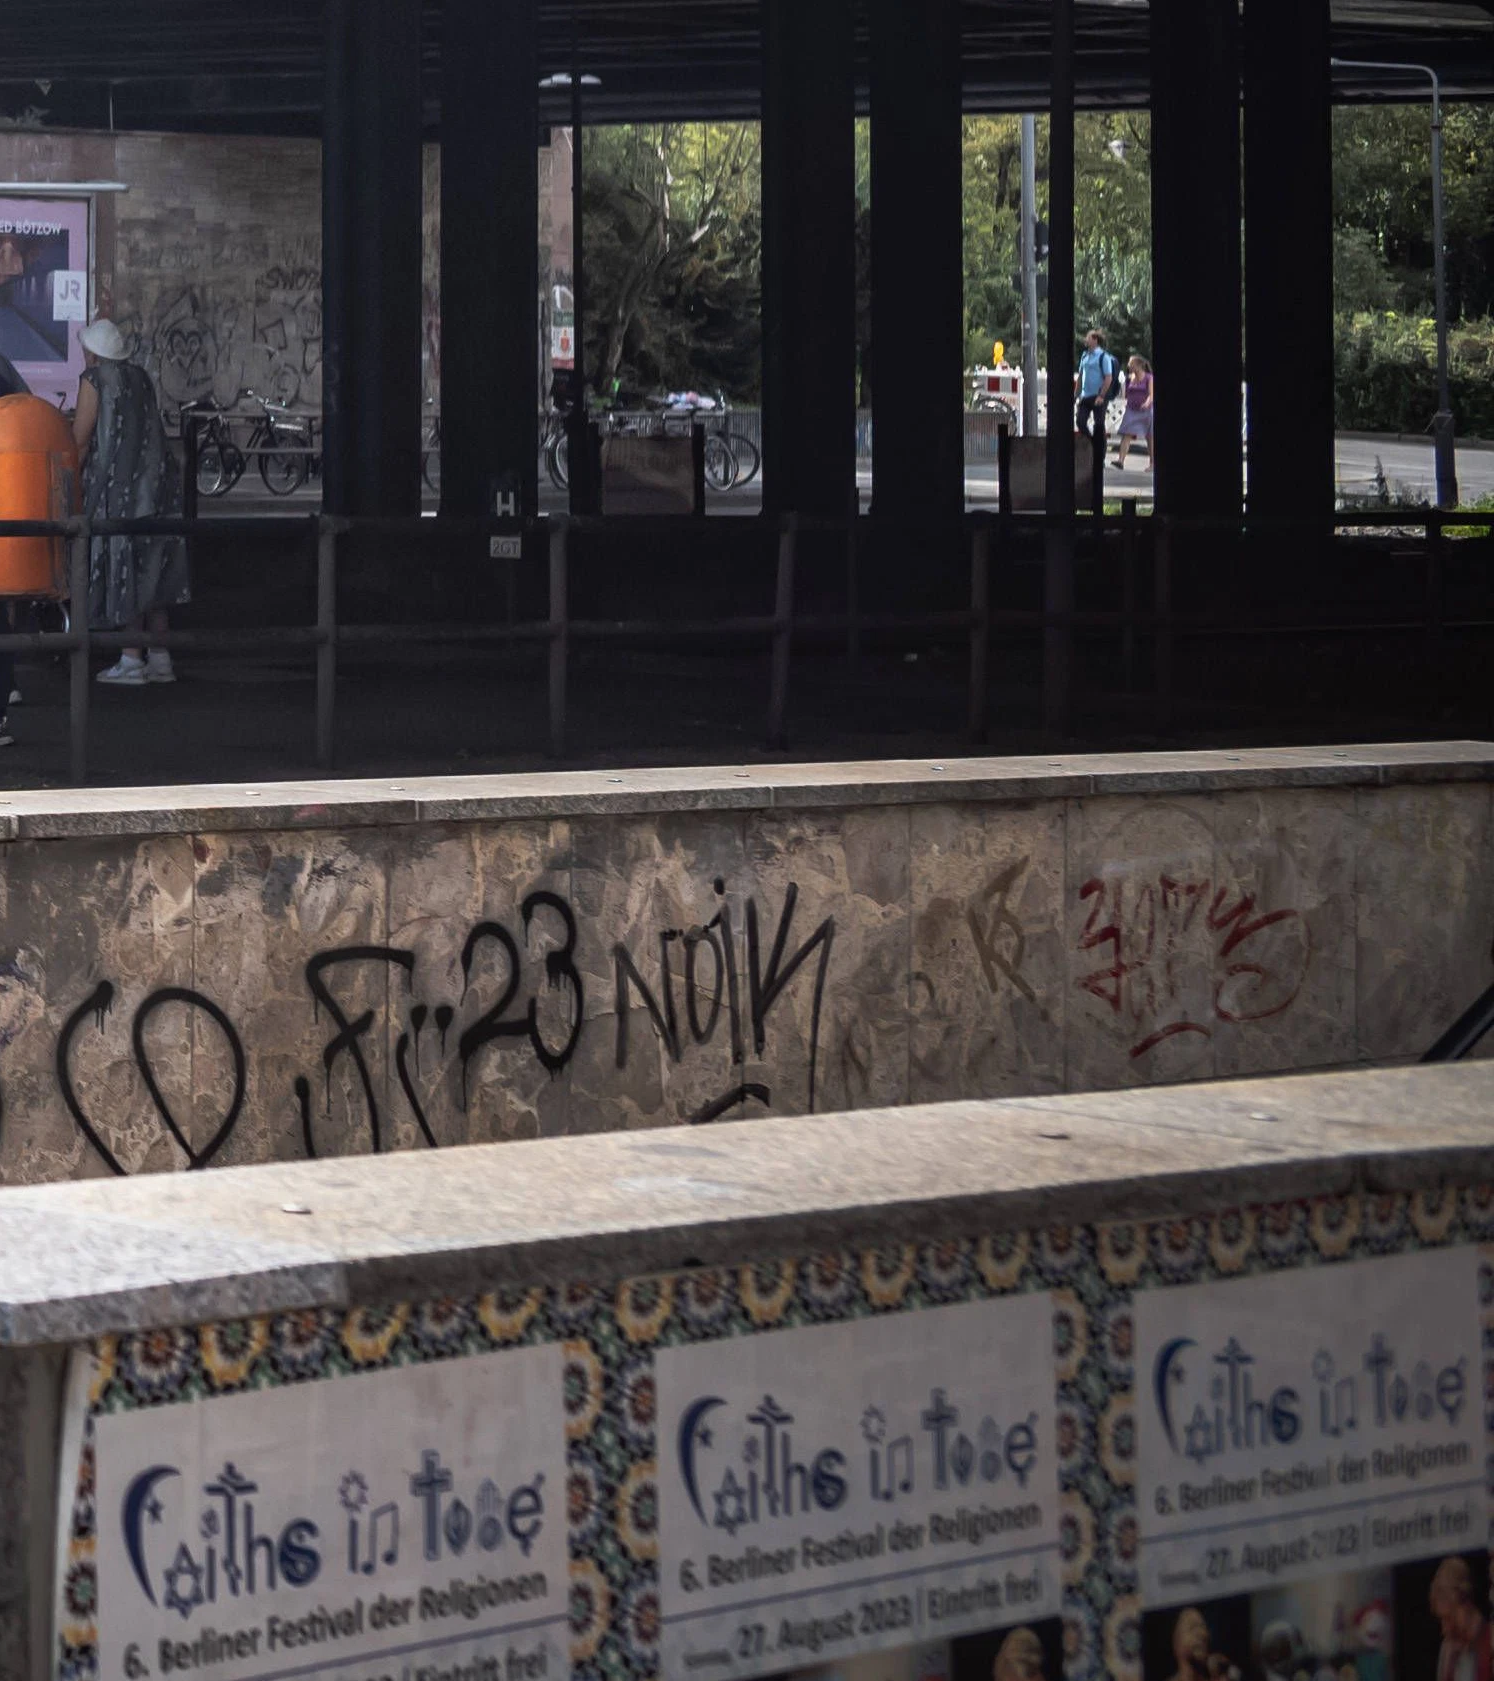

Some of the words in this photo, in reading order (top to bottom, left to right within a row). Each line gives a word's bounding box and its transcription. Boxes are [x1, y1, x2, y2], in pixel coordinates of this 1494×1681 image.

[1179, 1473, 1257, 1513] Berliner
[1261, 1459, 1331, 1498] Festival
[1336, 1451, 1368, 1486] der
[1371, 1439, 1471, 1480] Religionen
[707, 1544, 797, 1588] Berliner
[801, 1523, 886, 1570] Festival
[887, 1520, 926, 1554] der
[929, 1501, 1043, 1547] Religionen
[1241, 1536, 1310, 1574] August
[156, 1619, 262, 1675] Berliner
[266, 1596, 365, 1653] Festival
[367, 1590, 415, 1628] der
[419, 1570, 548, 1622] Religionen
[737, 1622, 774, 1660] 27.
[777, 1612, 855, 1654] August
[858, 1595, 914, 1635] 2023
[927, 1578, 1002, 1620] Eintritt
[1004, 1566, 1042, 1605] frei
[504, 1640, 548, 1681] frei
